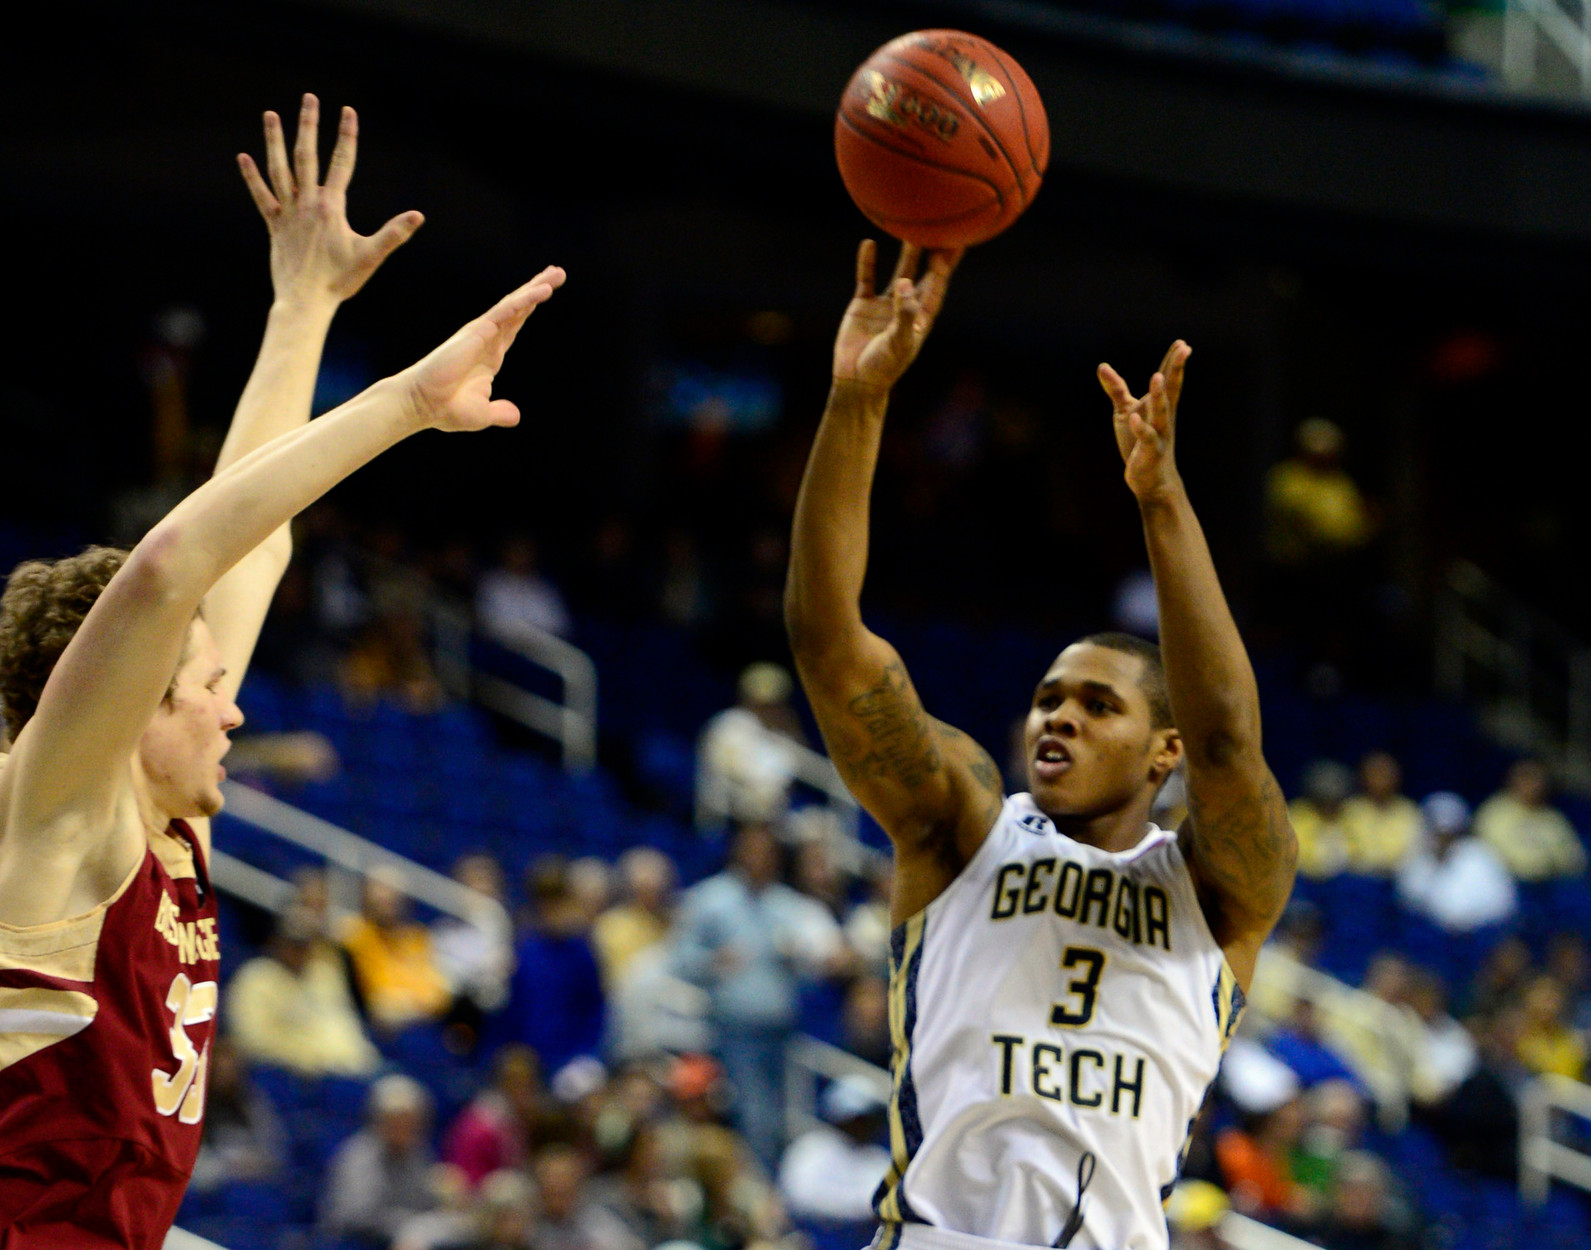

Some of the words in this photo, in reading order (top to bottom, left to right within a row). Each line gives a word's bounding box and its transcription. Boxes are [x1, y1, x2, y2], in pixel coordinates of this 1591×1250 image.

[989, 857, 1173, 952] GEORGIA
[1049, 945, 1106, 1029] 3
[990, 1033, 1146, 1120] TECH
